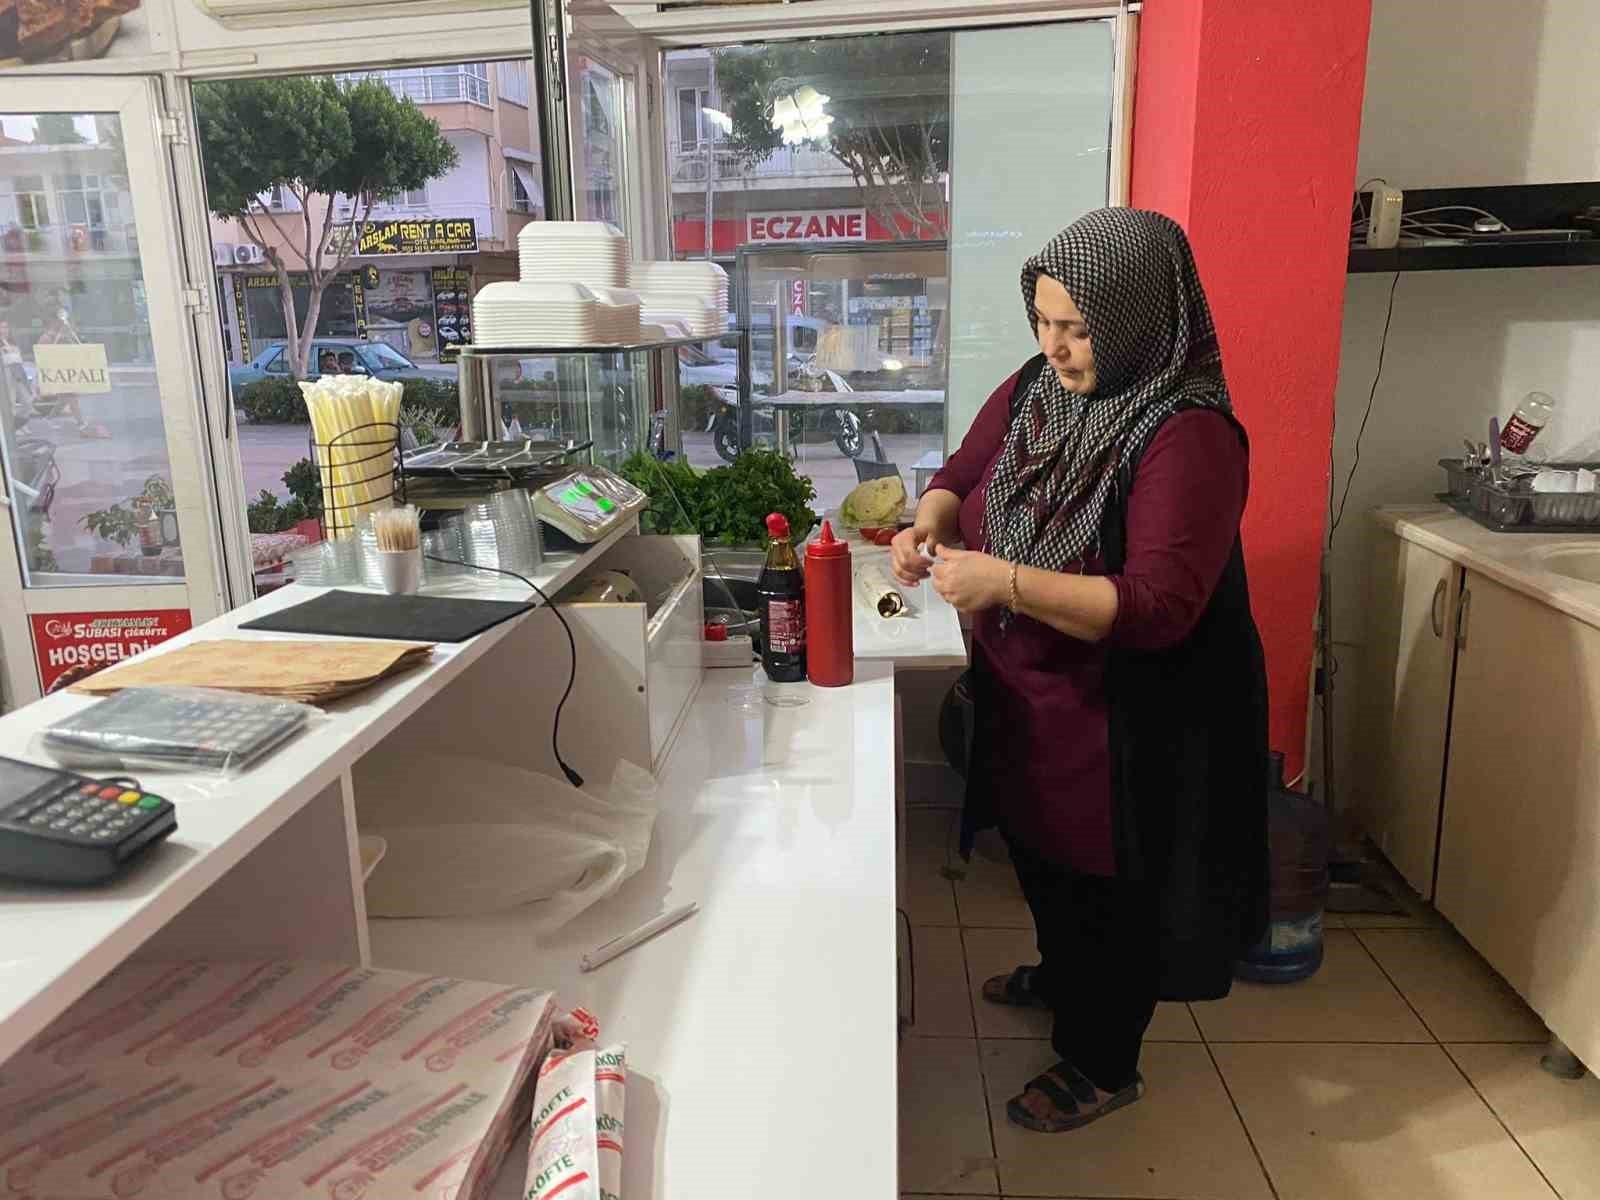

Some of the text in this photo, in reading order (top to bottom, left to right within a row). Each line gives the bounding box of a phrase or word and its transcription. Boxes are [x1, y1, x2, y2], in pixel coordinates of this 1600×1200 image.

[359, 223, 399, 252] ARSLAN
[400, 223, 431, 239] RENT
[435, 223, 444, 238] A
[447, 222, 472, 238] CAR
[750, 214, 862, 240] ECZANE
[247, 276, 281, 289] ARSLA
[40, 368, 105, 384] KAPALI
[49, 640, 156, 667] HOŞGELDİ
